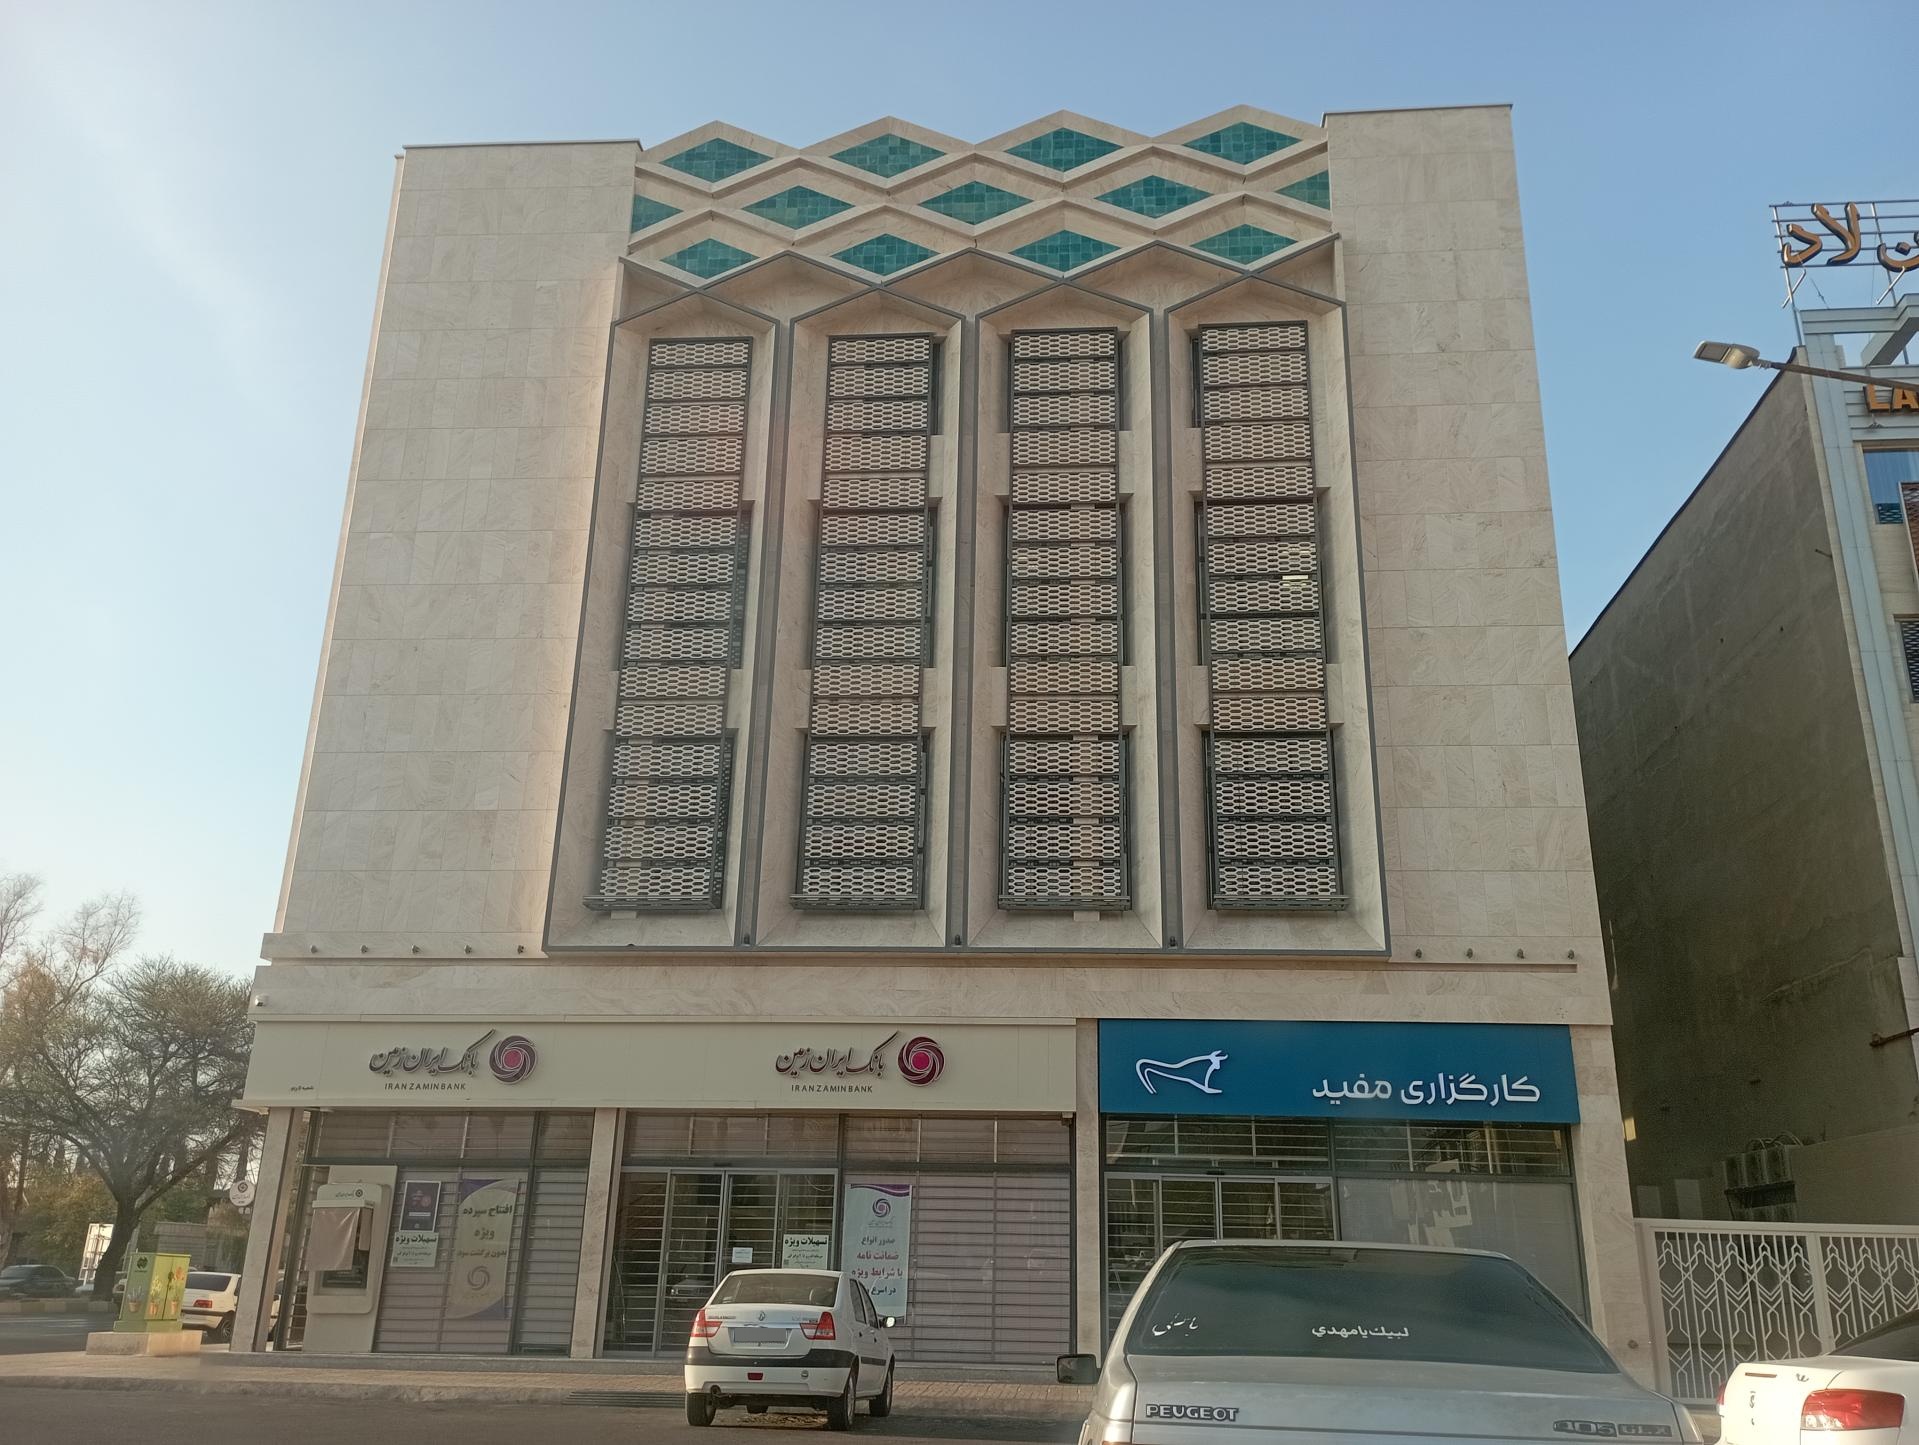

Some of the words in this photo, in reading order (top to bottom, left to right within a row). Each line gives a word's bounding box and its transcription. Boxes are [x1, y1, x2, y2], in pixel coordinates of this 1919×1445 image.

[1863, 383, 1919, 412] LA
[403, 1047, 449, 1076] ایران
[437, 1028, 496, 1077] بانک
[809, 1047, 853, 1076] ایران
[846, 1030, 899, 1078] بانک
[369, 1047, 407, 1077] زمین
[775, 1047, 811, 1077] زمین
[1312, 1073, 1393, 1105] مفید
[1400, 1072, 1541, 1106] کارگزاری
[395, 1234, 410, 1245] ویژه
[474, 1227, 495, 1240] ویژه
[784, 1237, 800, 1247] ویژه
[800, 1236, 828, 1247] تسهیلات
[861, 1235, 877, 1245] انواع
[878, 1237, 896, 1246] صدور
[851, 1268, 869, 1279] ویژه
[870, 1267, 896, 1279] شرایط
[871, 1285, 888, 1296] اسرع
[1146, 1404, 1239, 1422] PEUGEOT
